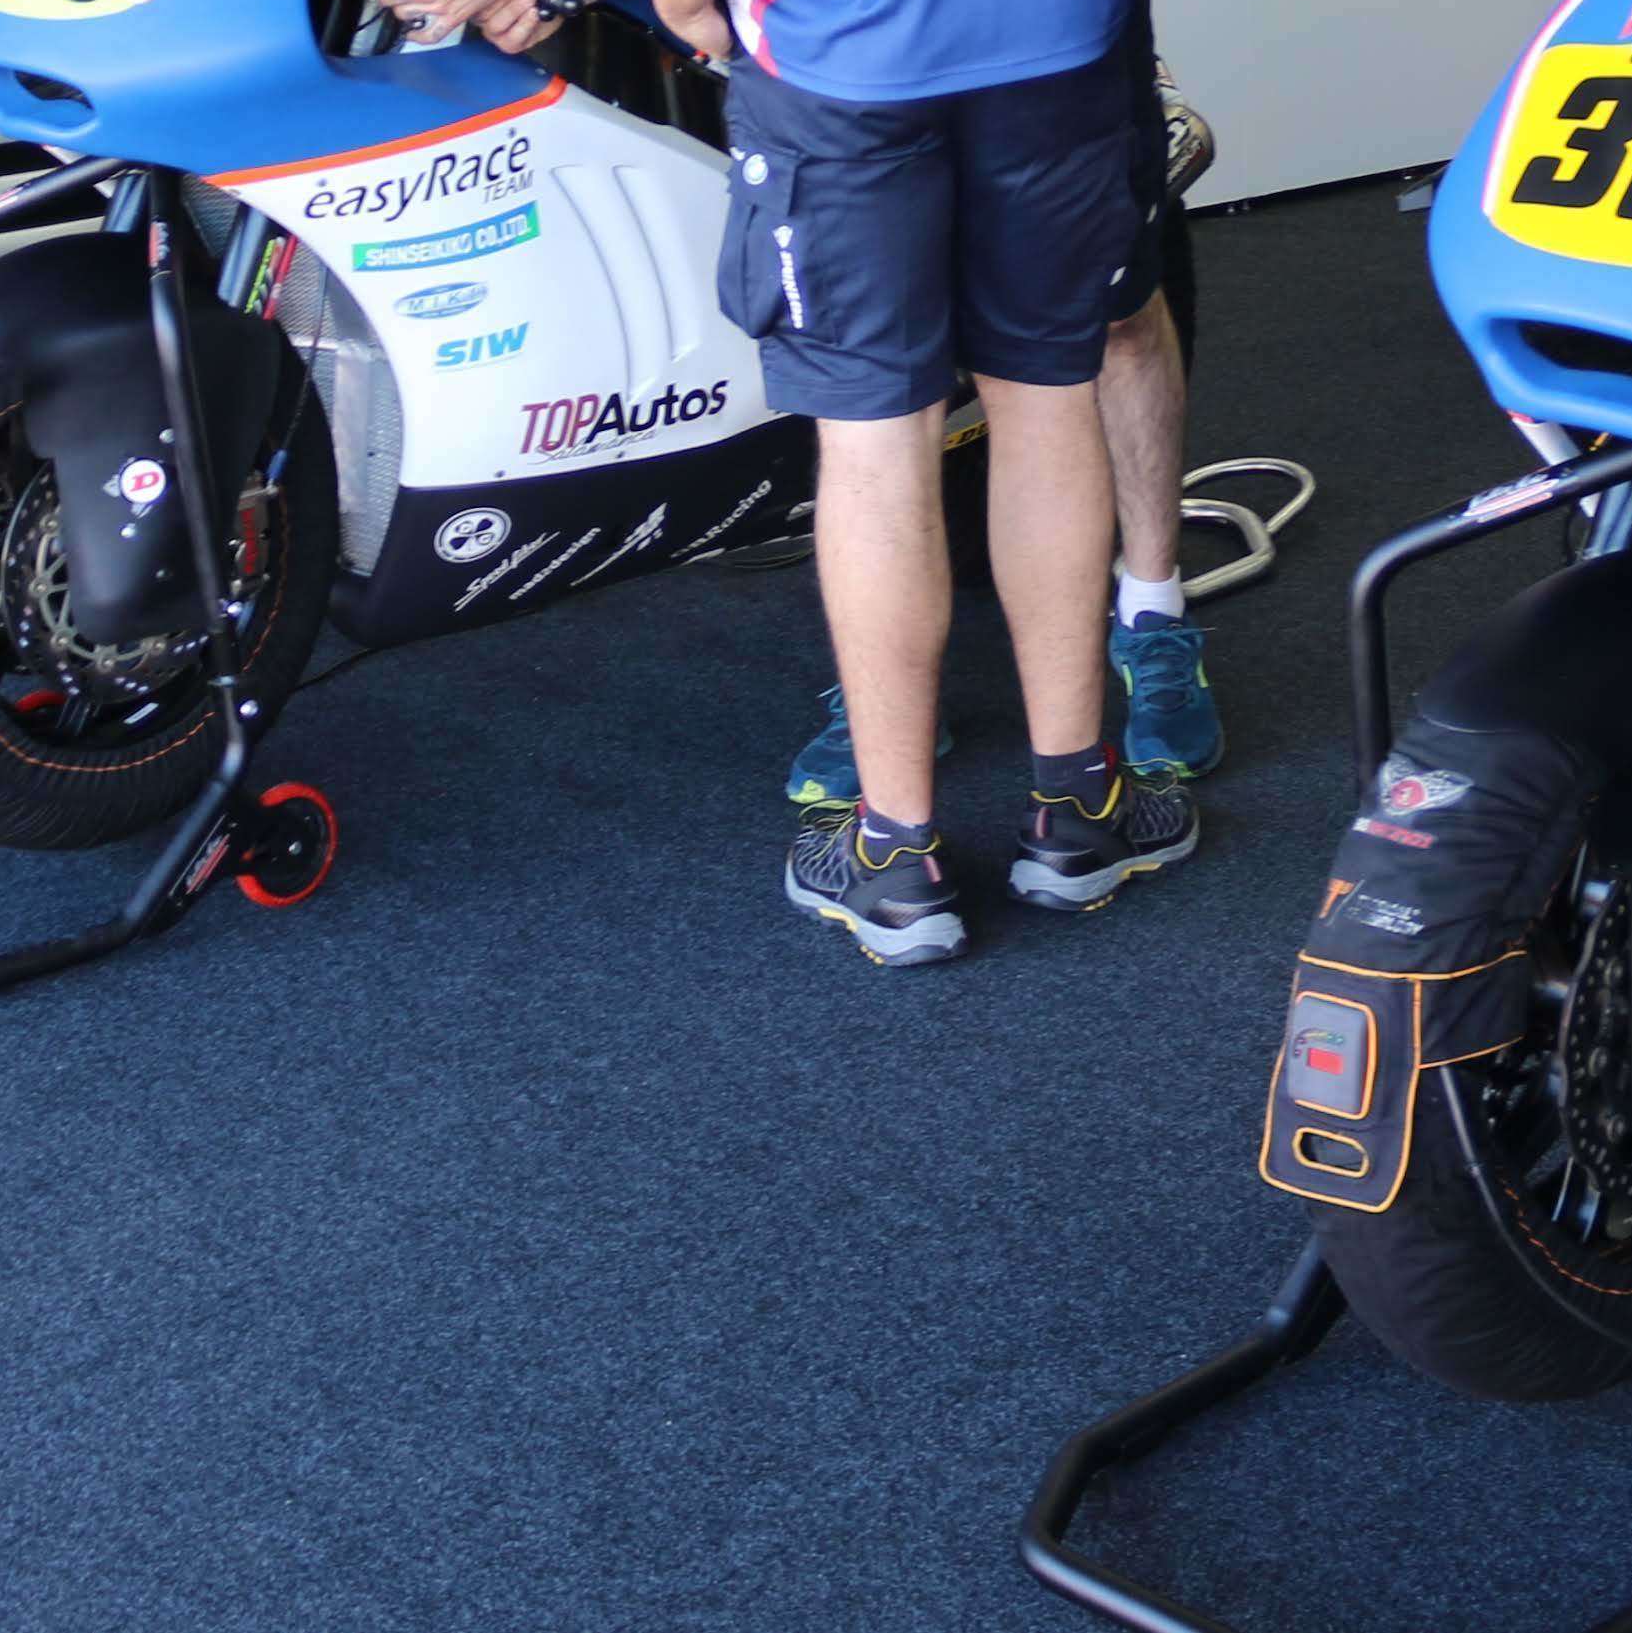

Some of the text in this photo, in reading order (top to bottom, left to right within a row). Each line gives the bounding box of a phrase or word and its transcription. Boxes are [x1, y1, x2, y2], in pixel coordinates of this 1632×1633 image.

[304, 135, 530, 222] easyRace
[484, 170, 535, 204] TEAM
[434, 321, 530, 367] SIW
[520, 380, 730, 454] TOPAutos
